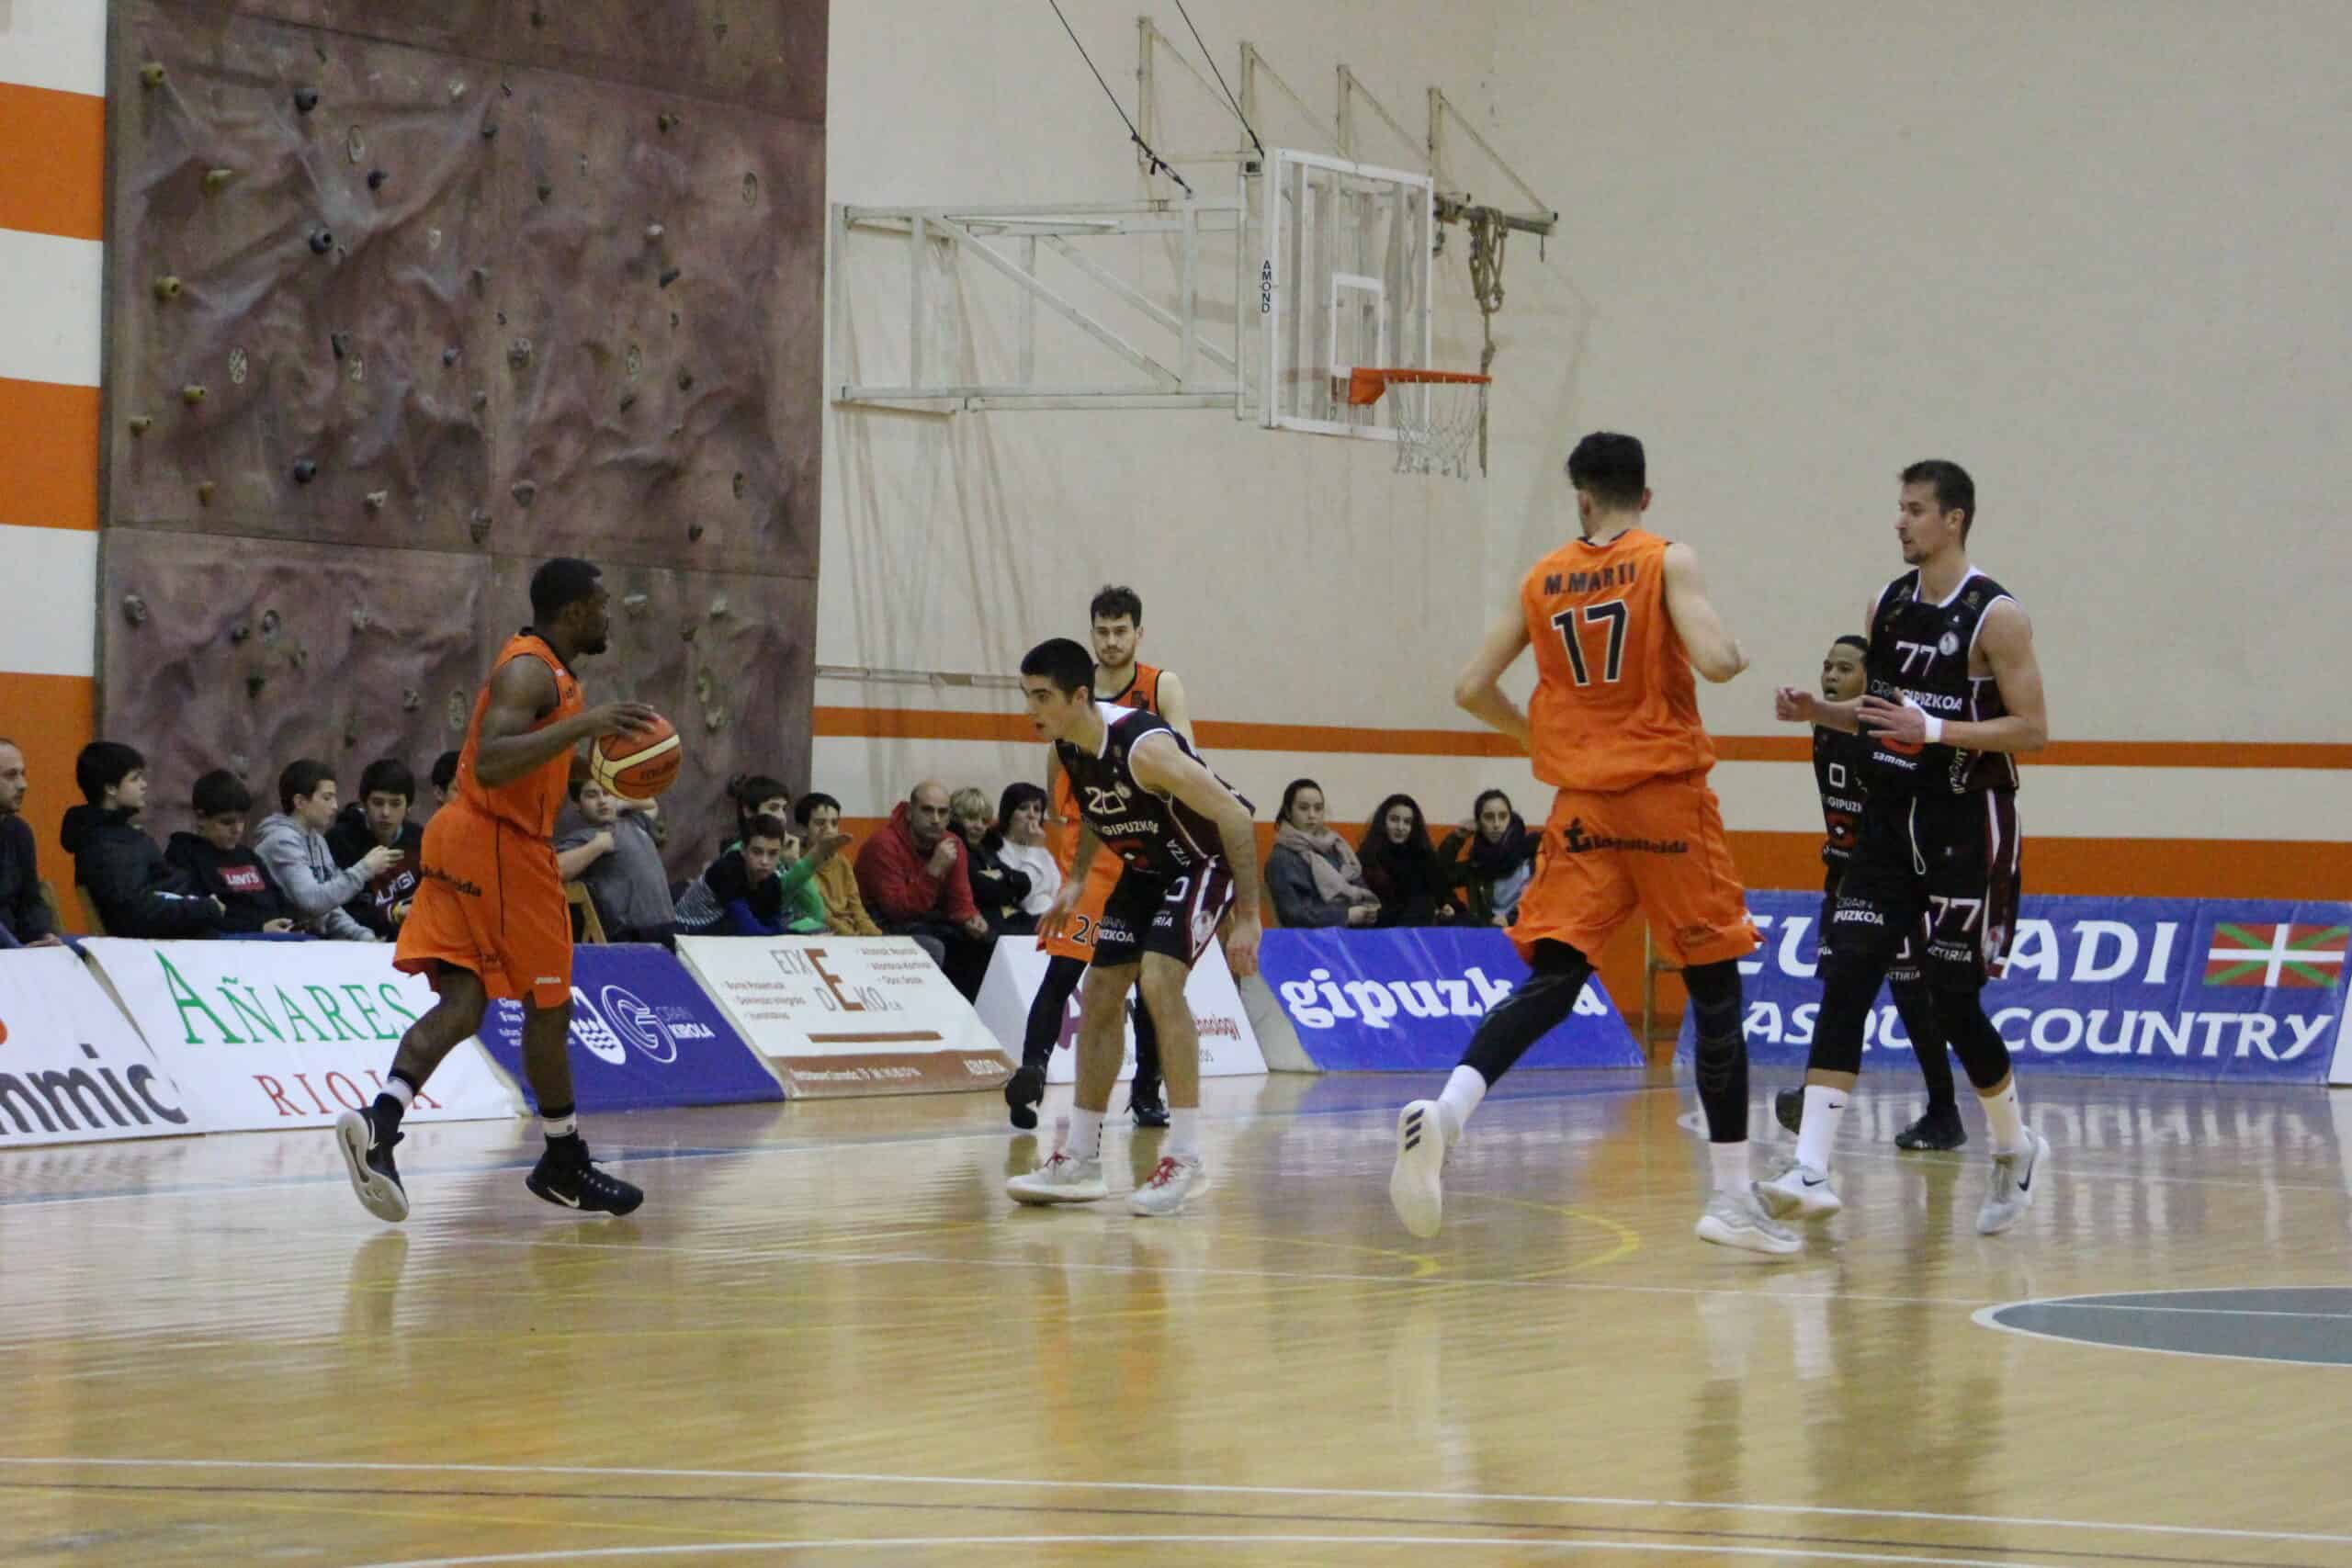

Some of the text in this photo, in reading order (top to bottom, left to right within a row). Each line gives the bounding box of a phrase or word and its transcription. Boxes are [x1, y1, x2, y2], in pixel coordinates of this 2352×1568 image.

[1261, 260, 1272, 313] AMOND
[1544, 562, 1636, 595] M.MARTI
[1551, 598, 1629, 687] 17
[1895, 640, 1936, 677] 77
[1085, 785, 1127, 815] 20
[1928, 895, 1982, 932] 77
[1737, 914, 2177, 984] UADI
[154, 950, 420, 1044] AÑARES
[1280, 967, 1608, 1030] gipuzka
[1990, 1007, 2335, 1062] COUNTRY
